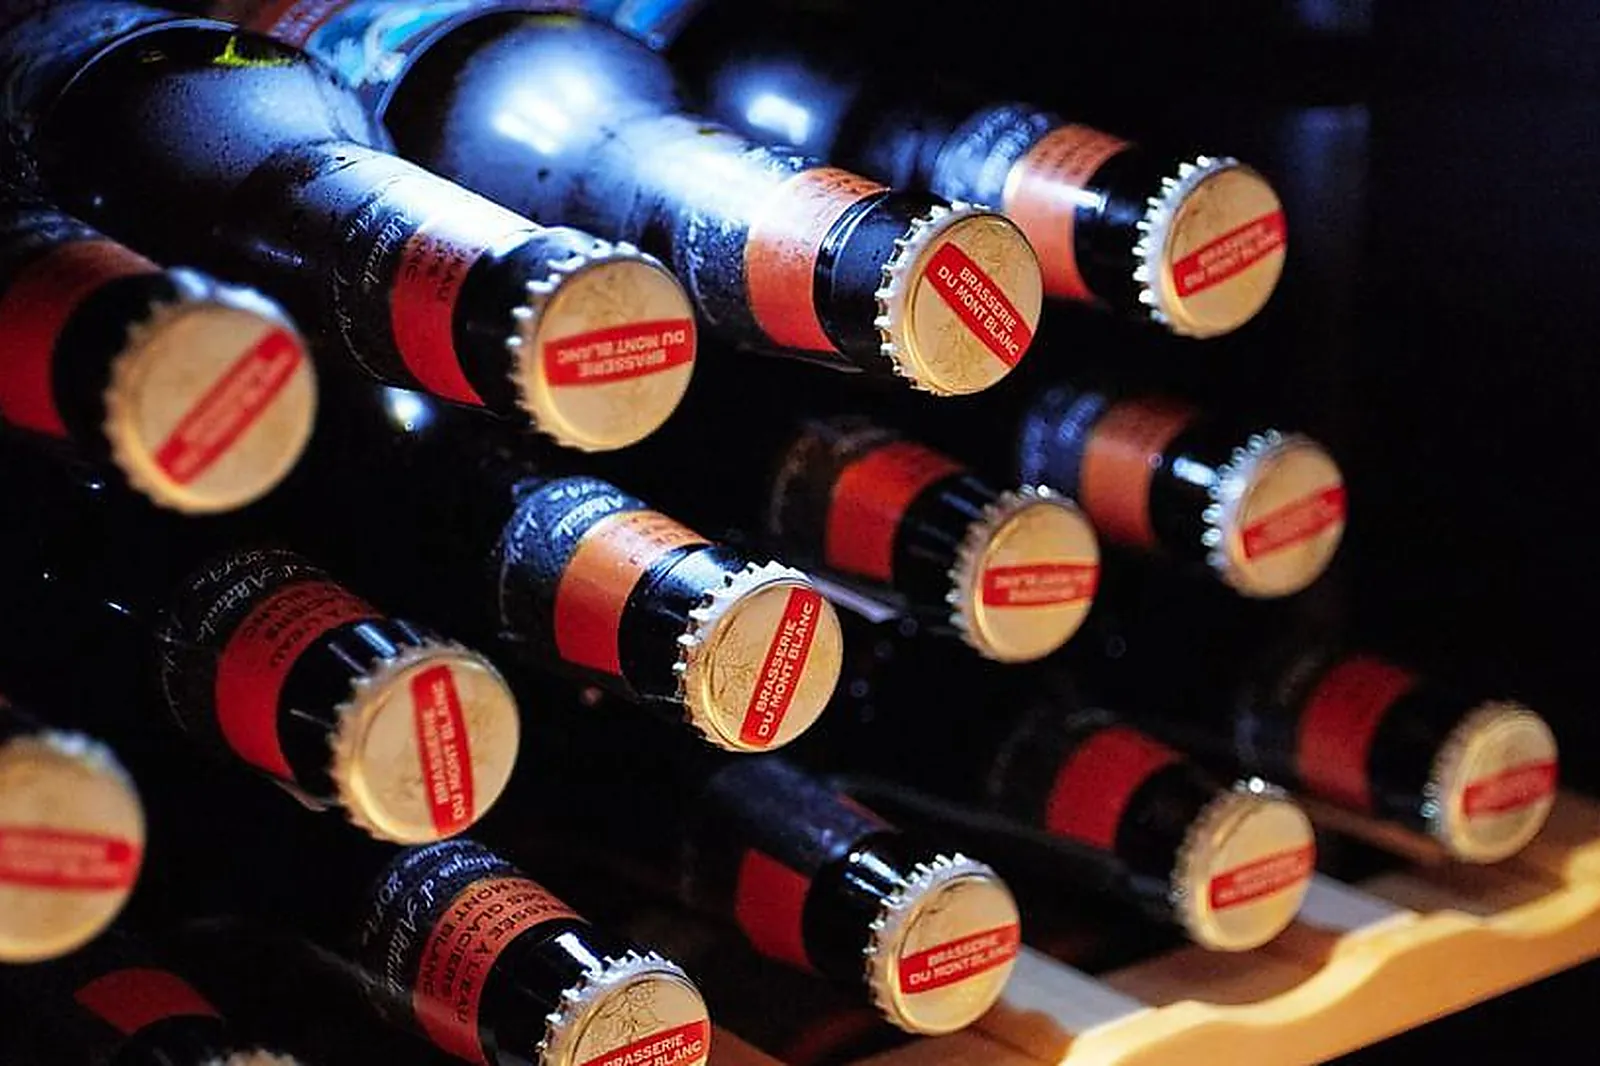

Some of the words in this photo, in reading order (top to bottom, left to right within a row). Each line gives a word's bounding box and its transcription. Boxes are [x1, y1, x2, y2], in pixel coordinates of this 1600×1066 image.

[662, 329, 686, 346] DU
[937, 266, 959, 289] DU
[955, 285, 988, 320] MONT
[983, 315, 1019, 356] BLANC
[959, 266, 1017, 333] BRASSERIE
[754, 618, 798, 713] BRASSERIE
[757, 711, 776, 738] DU
[769, 662, 795, 708] MONT
[787, 601, 814, 660] BLANC
[908, 969, 932, 986] DU
